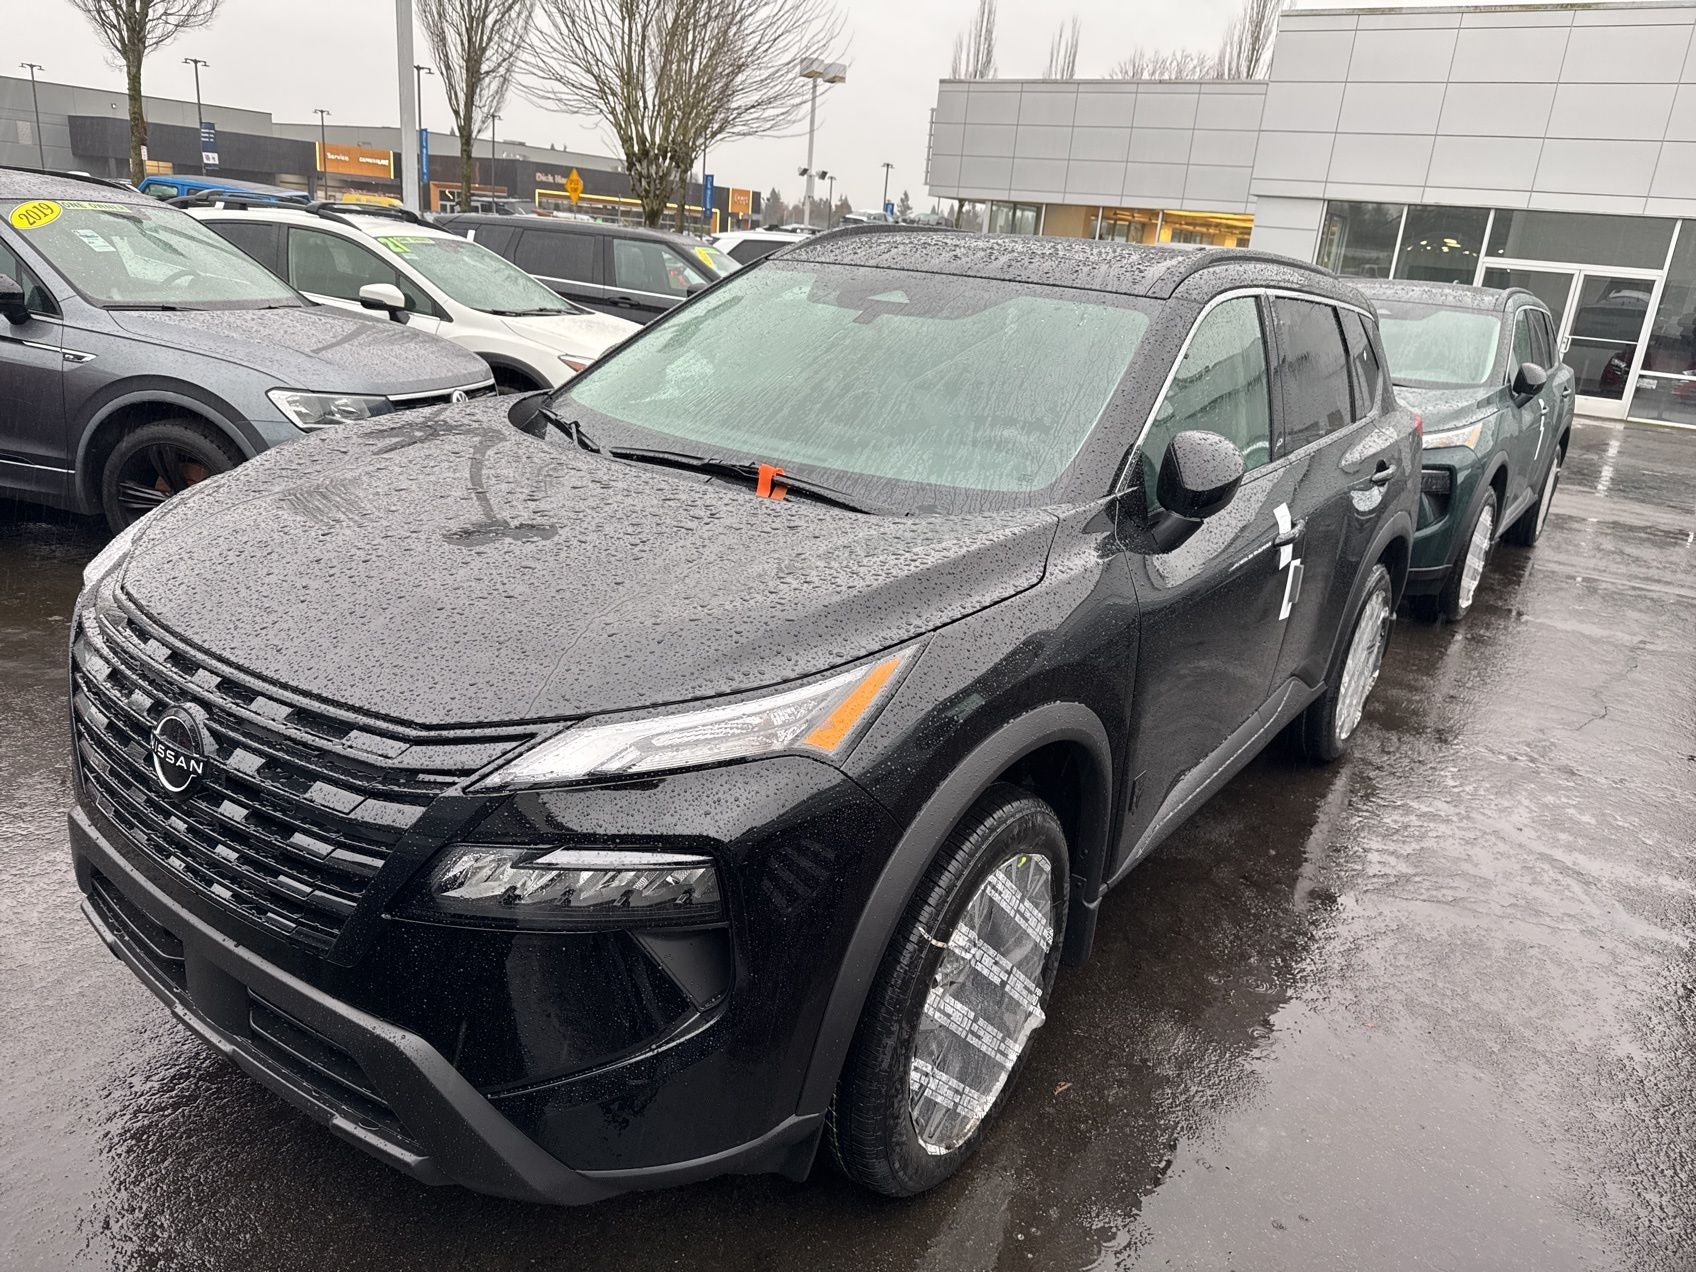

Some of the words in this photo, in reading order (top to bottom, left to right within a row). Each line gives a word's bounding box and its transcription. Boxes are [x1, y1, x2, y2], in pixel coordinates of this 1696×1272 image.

[535, 172, 554, 182] Dick
[61, 201, 87, 209] ONE
[18, 202, 54, 225] 2019
